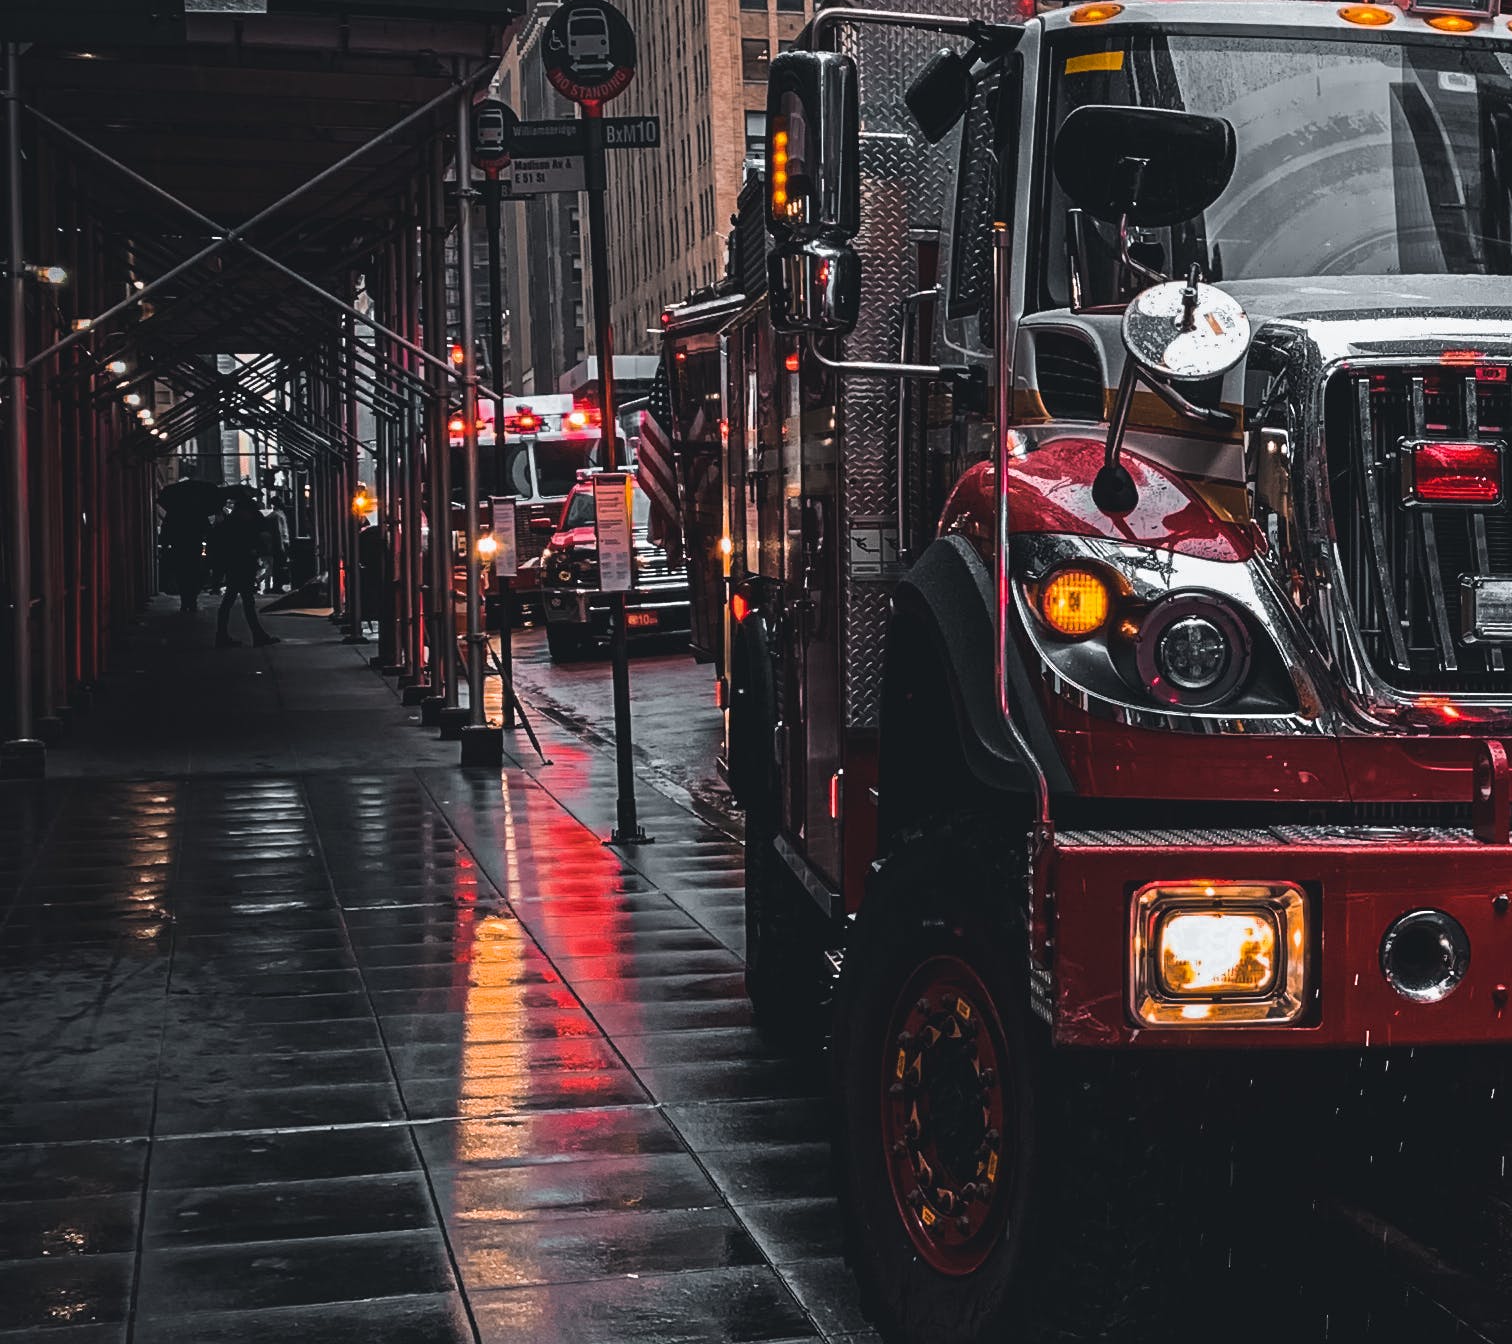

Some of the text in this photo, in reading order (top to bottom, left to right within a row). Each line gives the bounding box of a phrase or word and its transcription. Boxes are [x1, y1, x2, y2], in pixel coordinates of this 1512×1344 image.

[553, 69, 626, 98] NO STANDING
[606, 120, 656, 144] BxM10
[514, 159, 550, 171] Madison
[552, 158, 564, 170] Av
[515, 172, 521, 184] E
[522, 172, 534, 184] 51
